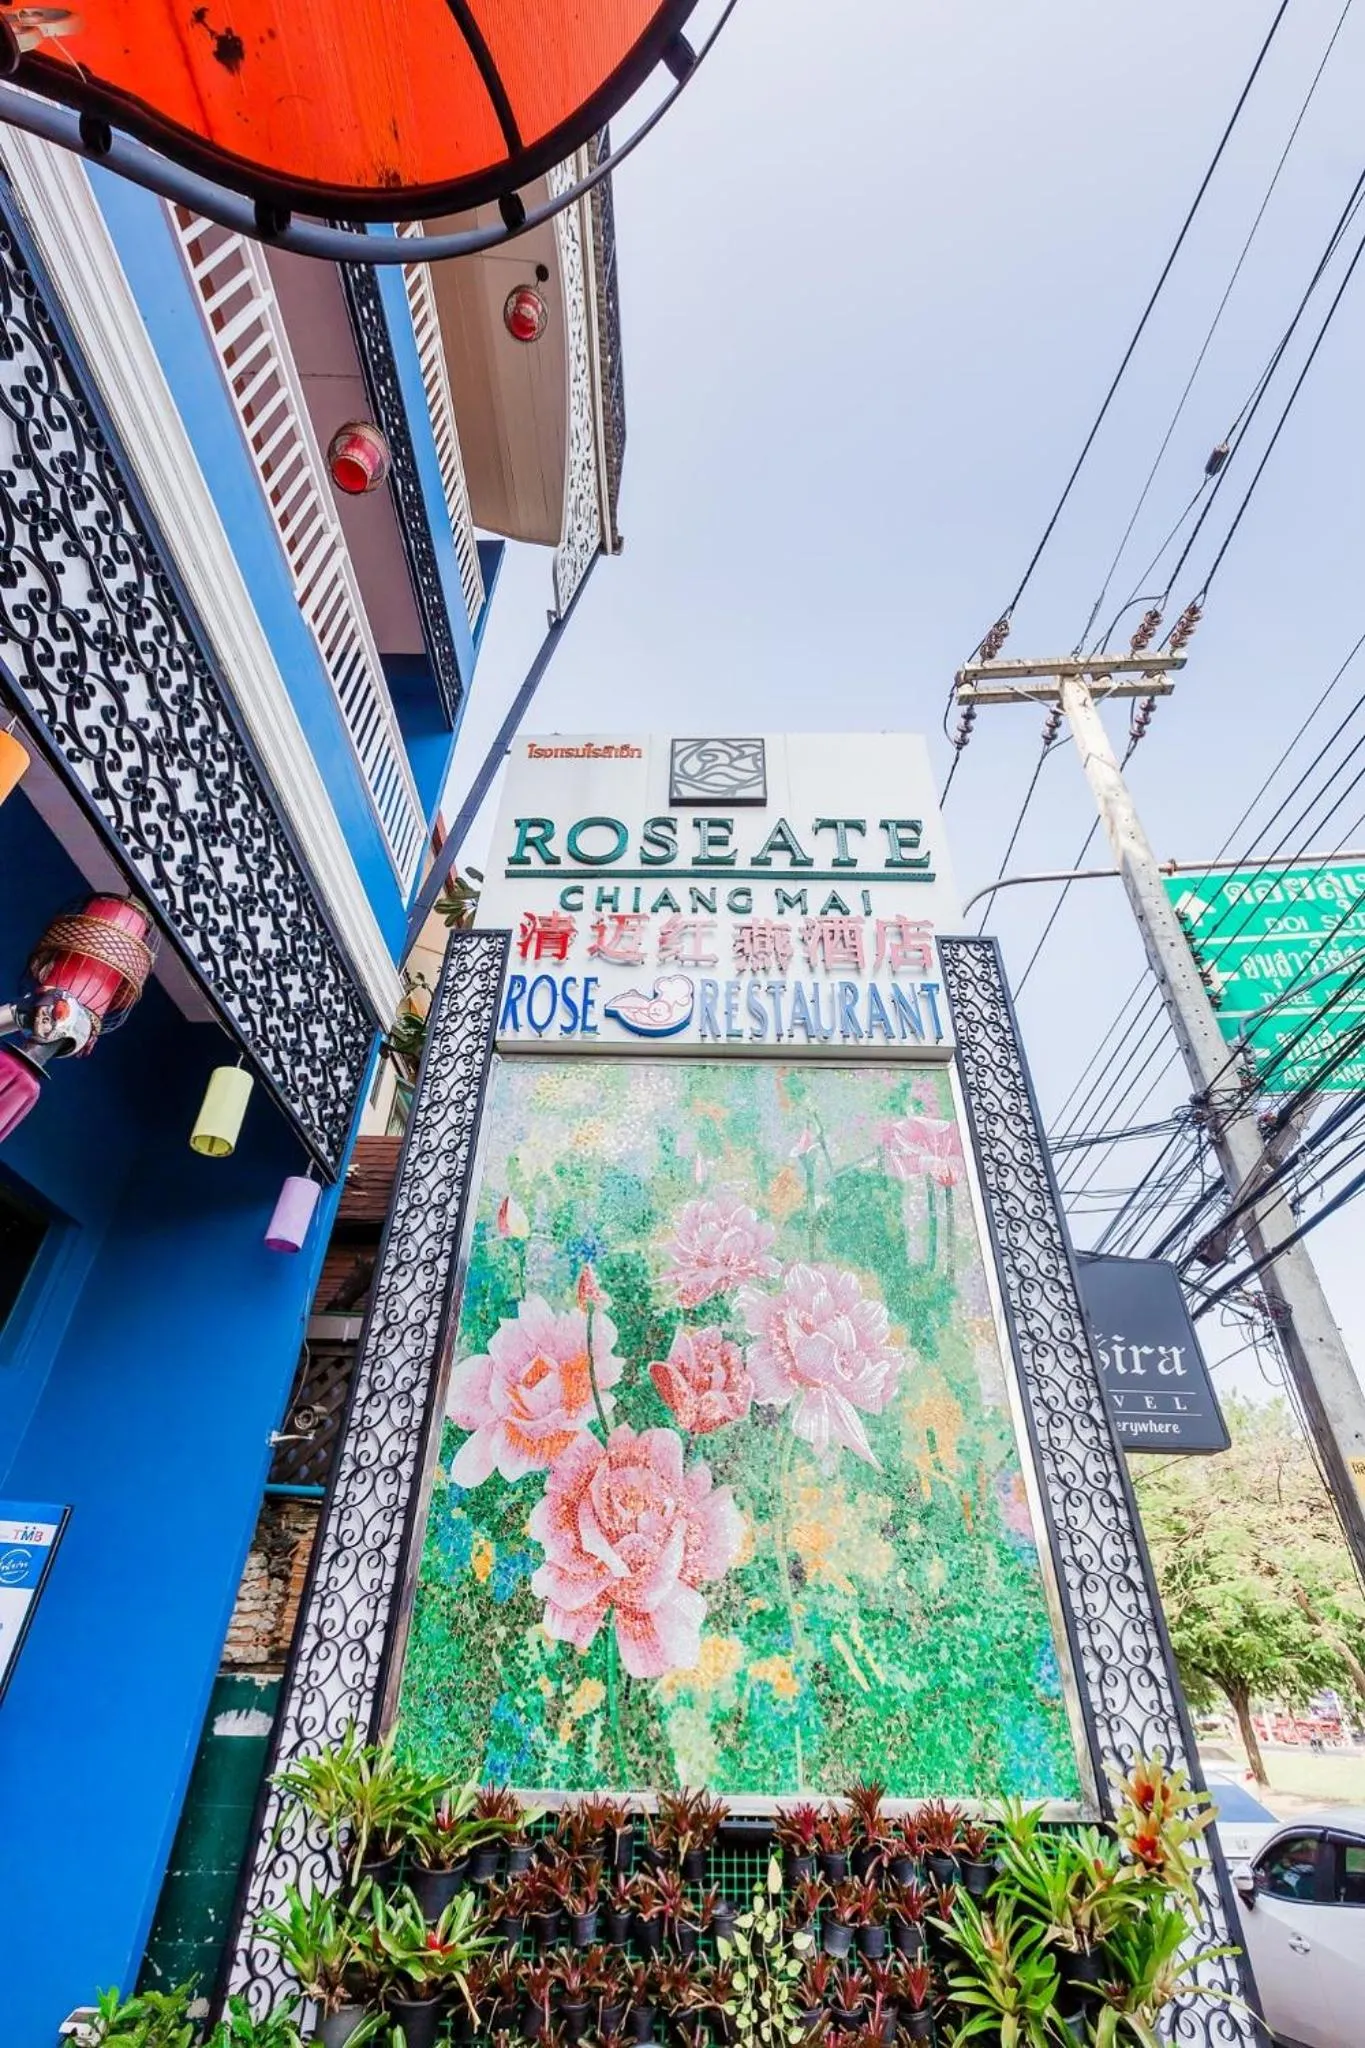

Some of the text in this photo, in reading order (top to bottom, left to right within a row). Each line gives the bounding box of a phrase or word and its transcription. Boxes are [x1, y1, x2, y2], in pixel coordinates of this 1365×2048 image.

[507, 815, 931, 867] ROSEATE
[559, 885, 873, 916] CHIANG MAI
[1264, 915, 1310, 933] DOI
[500, 973, 945, 1044] ROSE RESTAURANT
[13, 1528, 43, 1542] TMB
